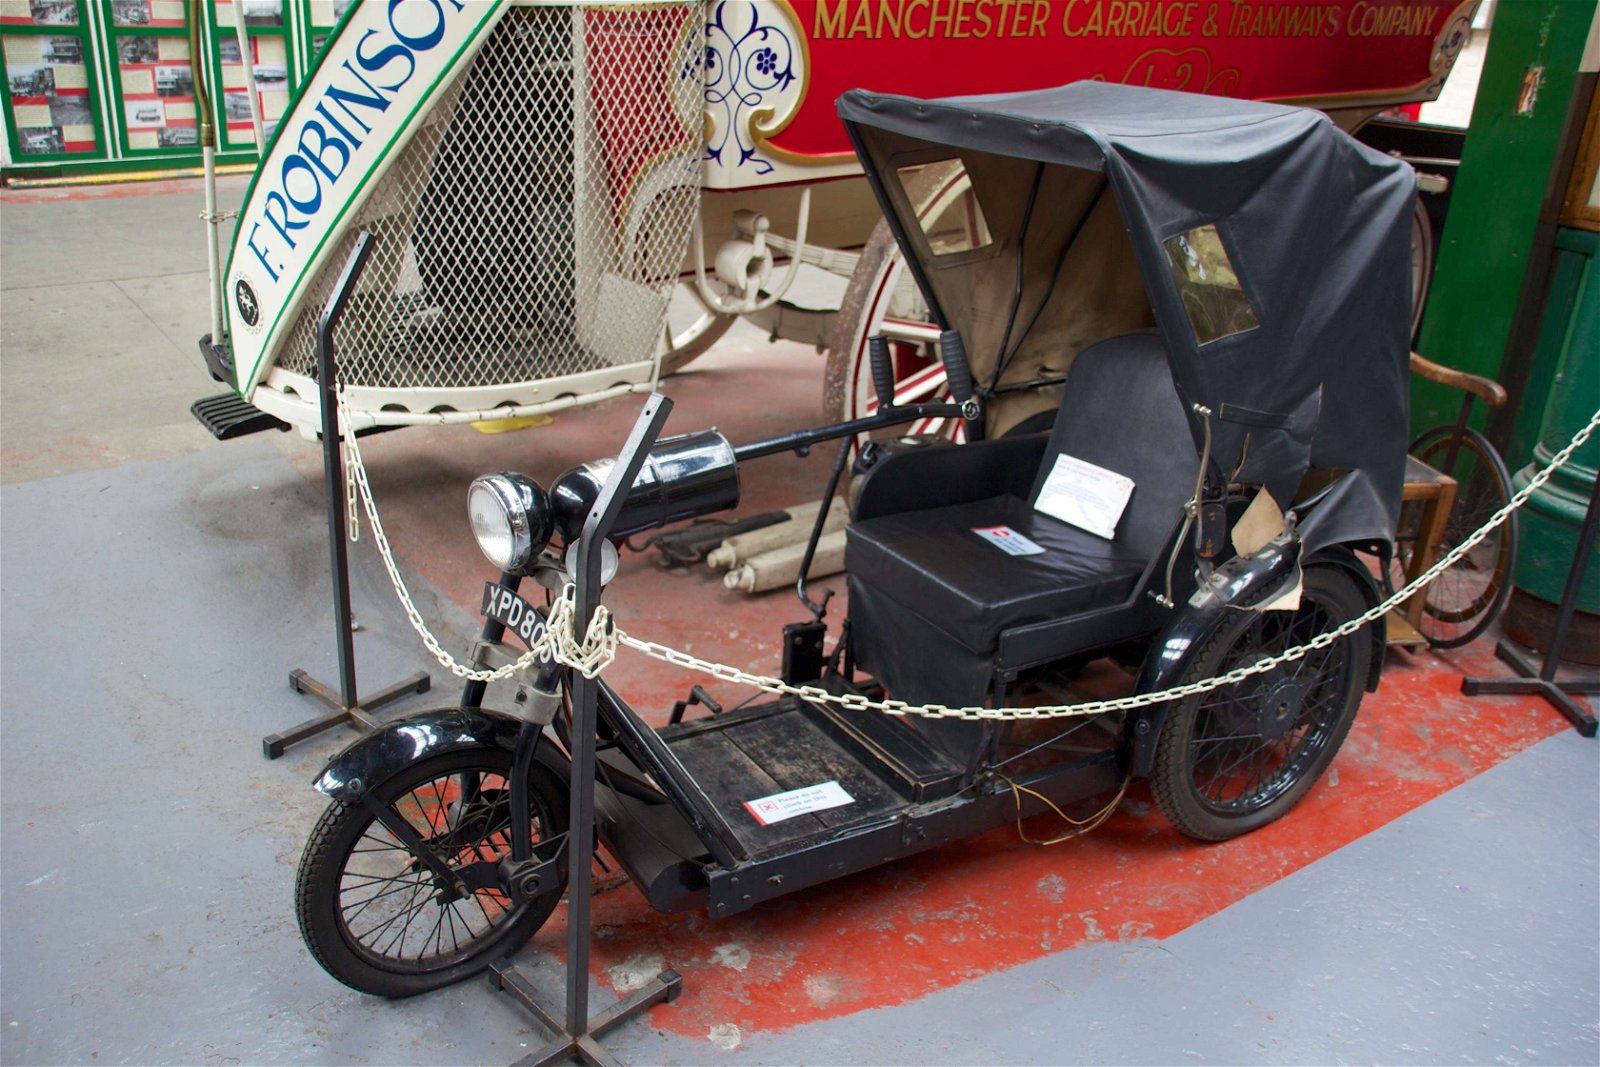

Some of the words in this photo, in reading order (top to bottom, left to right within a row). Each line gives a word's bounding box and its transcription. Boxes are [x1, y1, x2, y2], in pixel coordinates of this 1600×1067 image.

[812, 0, 1051, 39] MANCHESTER
[1062, 0, 1193, 38] CARRIAGE
[1201, 3, 1218, 37] &
[1227, 0, 1340, 37] TRAMWAYS
[264, 0, 465, 250] ROBINSO
[248, 222, 284, 284] F.
